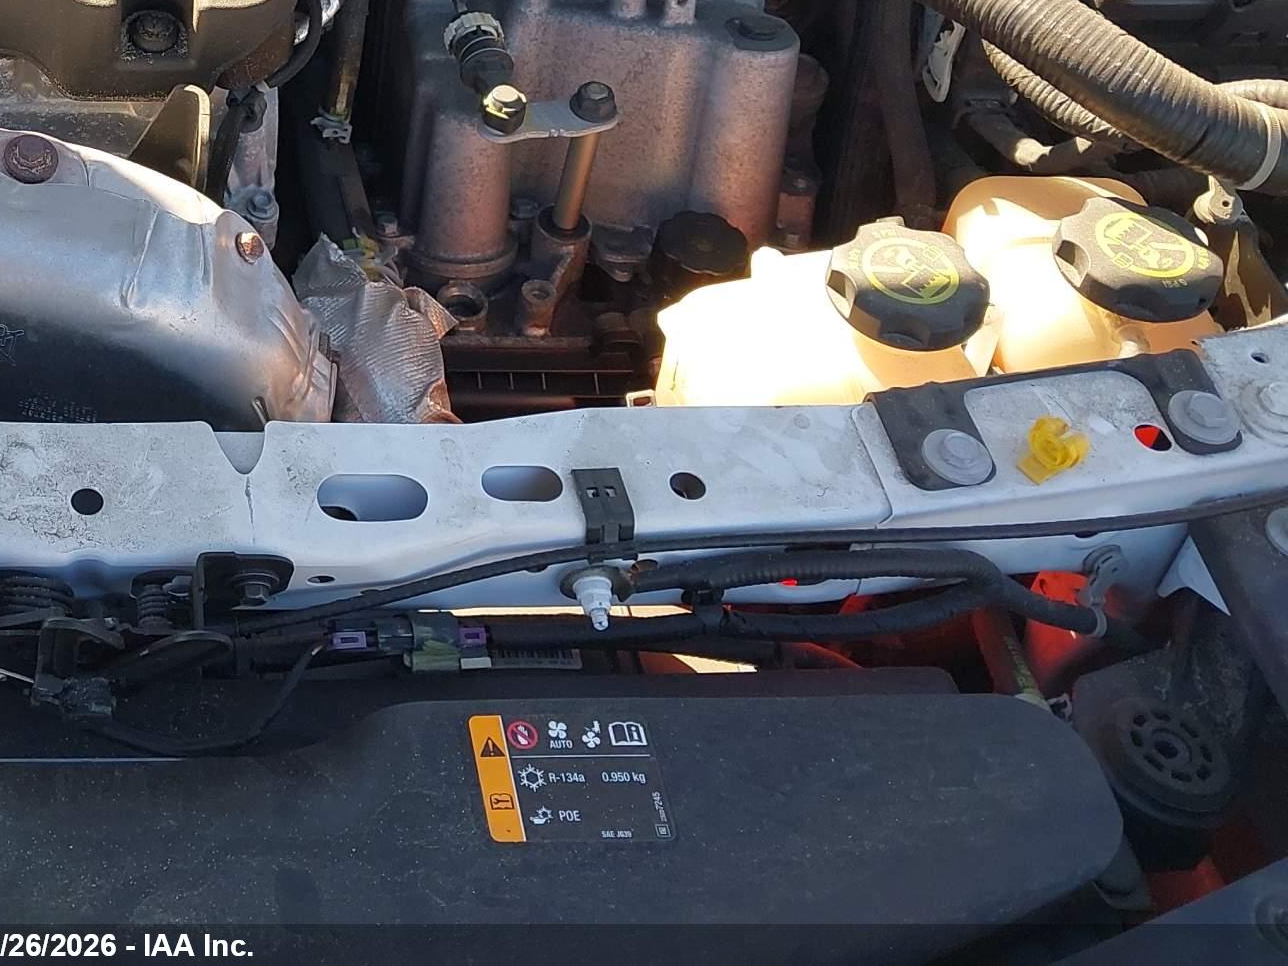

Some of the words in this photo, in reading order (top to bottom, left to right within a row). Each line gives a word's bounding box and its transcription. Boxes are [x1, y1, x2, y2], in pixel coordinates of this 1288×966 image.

[550, 740, 573, 749] AUTO
[549, 773, 586, 783] R-134a
[602, 772, 631, 783] 0.950
[632, 772, 646, 784] kg
[559, 810, 582, 822] POE
